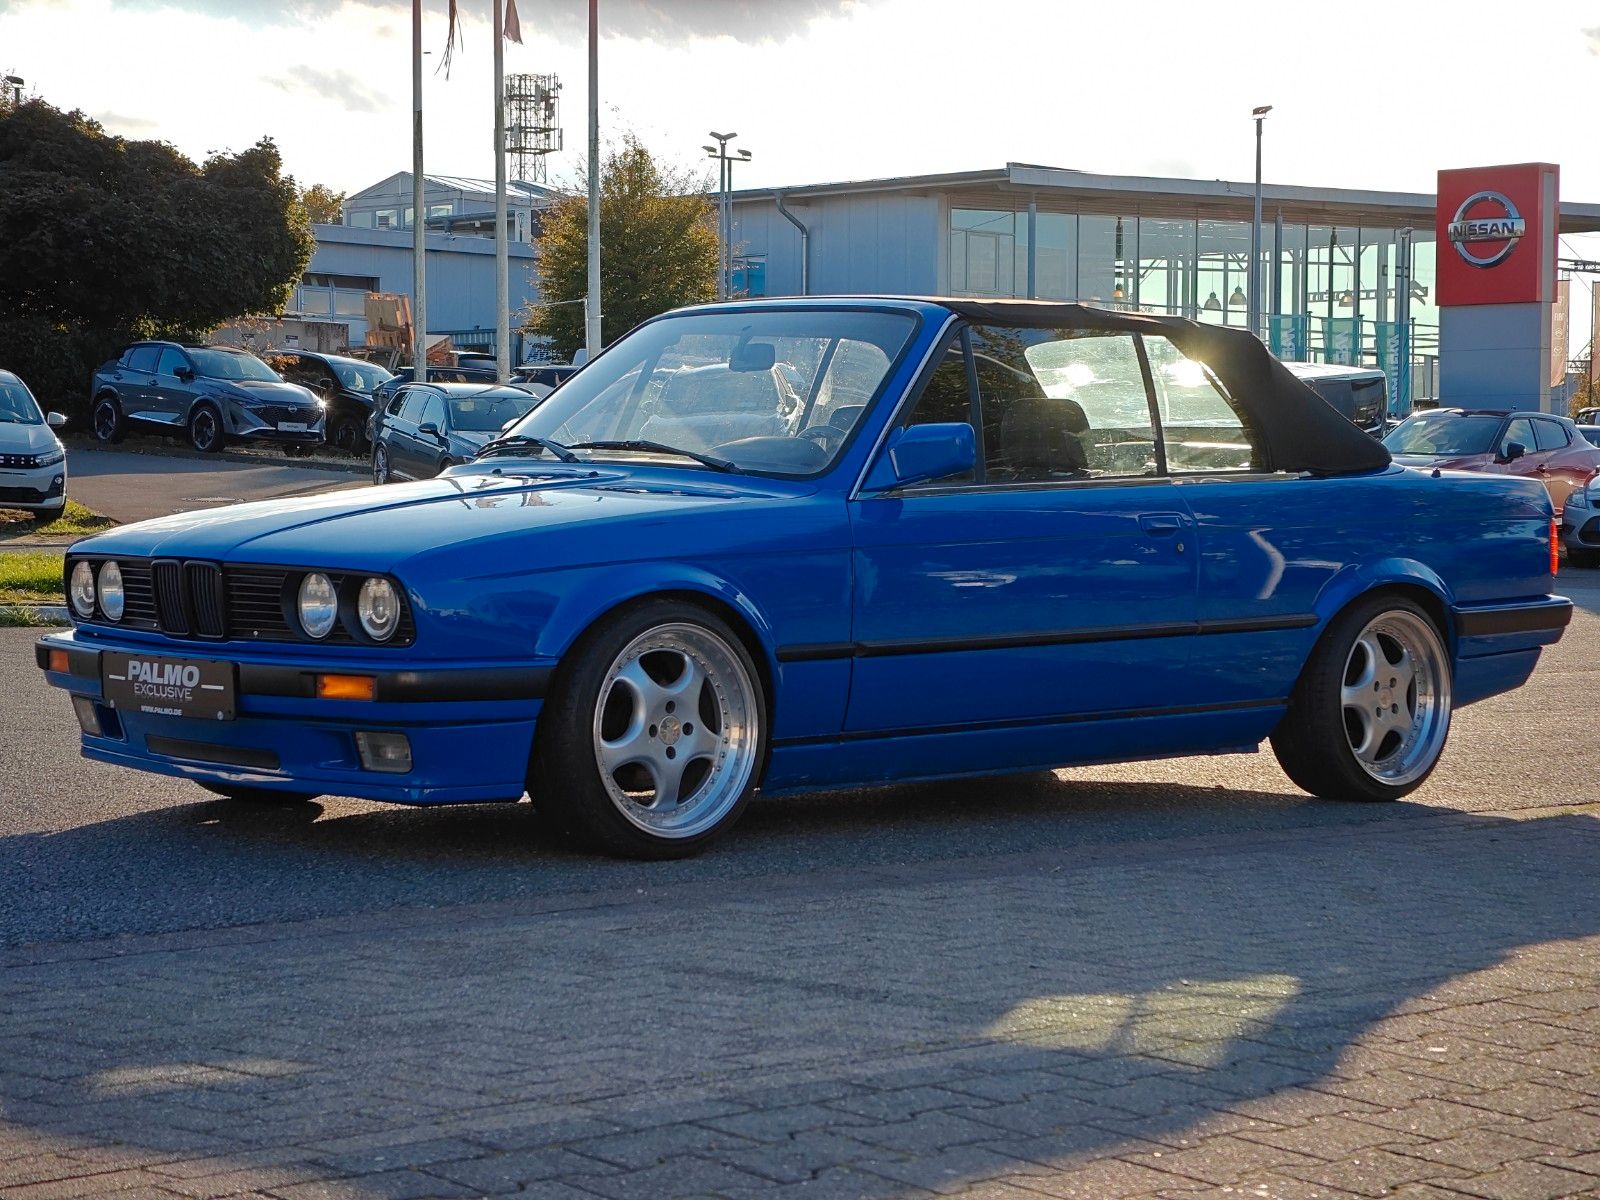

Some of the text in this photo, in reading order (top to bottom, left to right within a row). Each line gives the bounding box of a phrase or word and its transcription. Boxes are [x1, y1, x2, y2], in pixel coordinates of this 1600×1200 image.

[1453, 221, 1515, 238] NISSAN
[127, 660, 200, 688] PALMO
[134, 682, 193, 700] EXCLUSIVE
